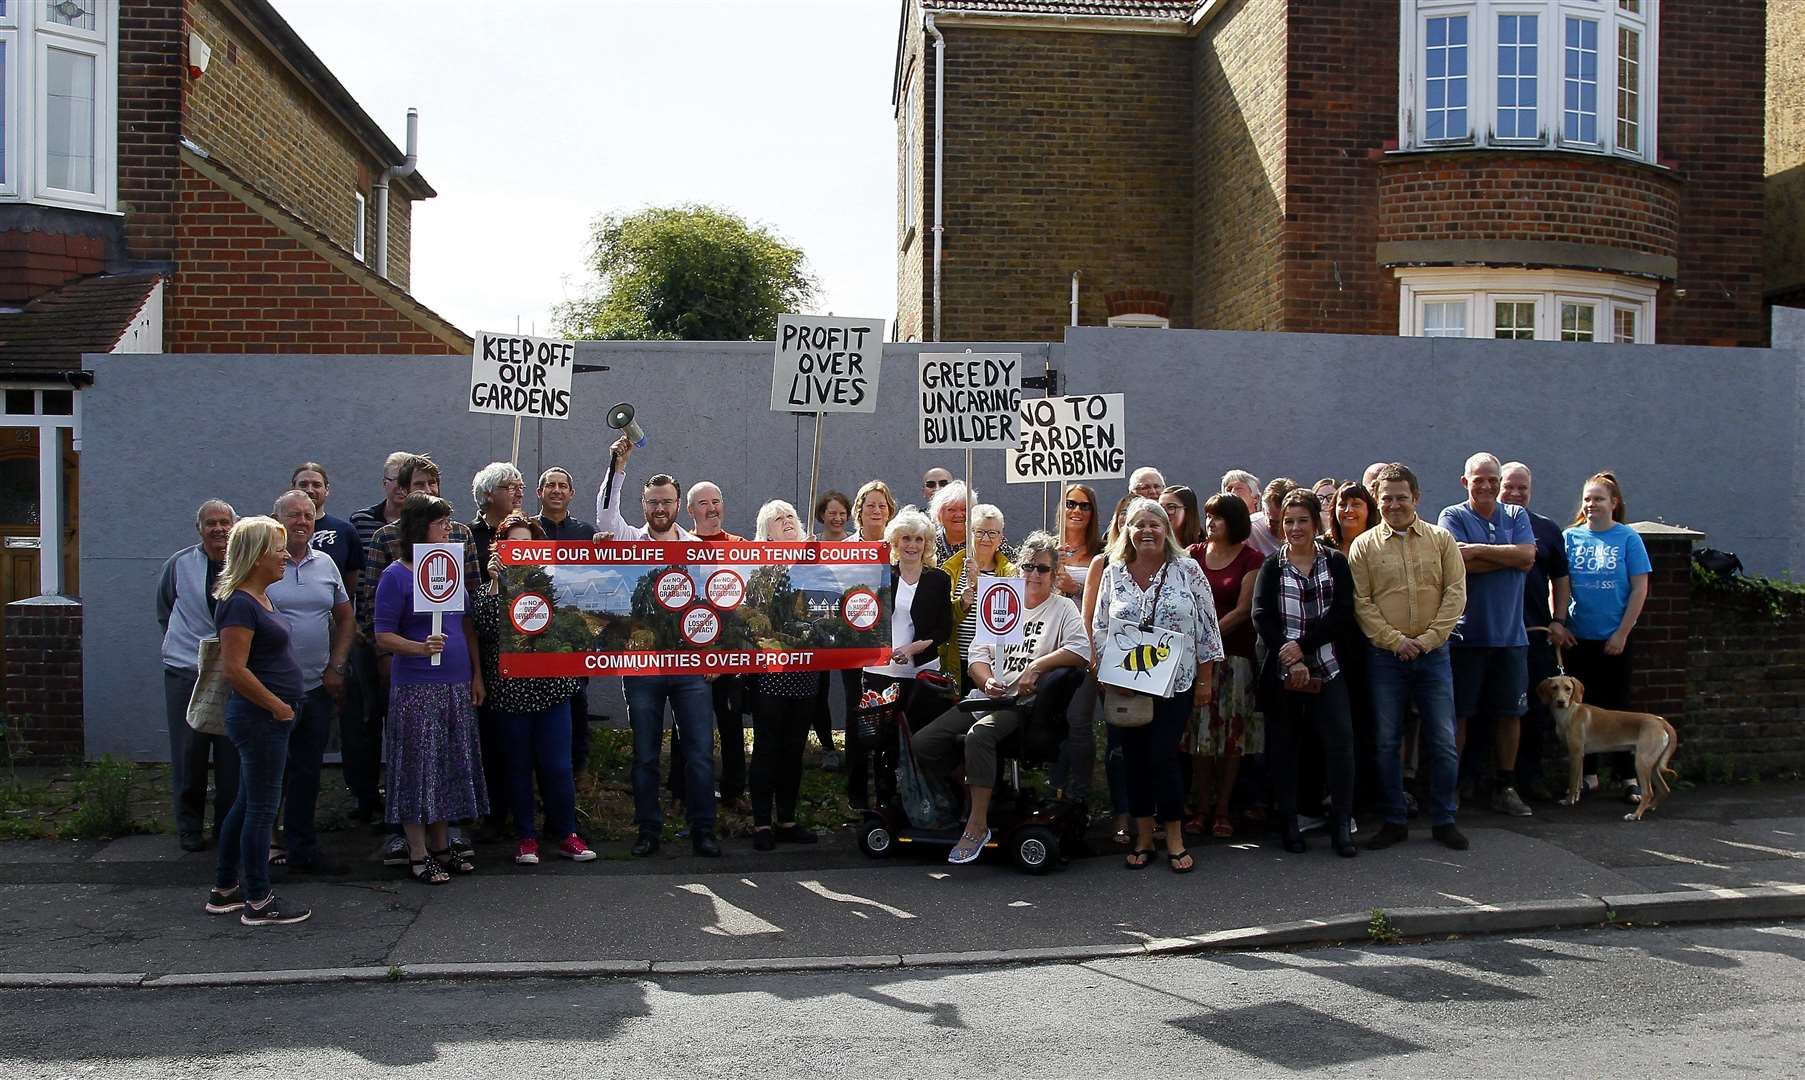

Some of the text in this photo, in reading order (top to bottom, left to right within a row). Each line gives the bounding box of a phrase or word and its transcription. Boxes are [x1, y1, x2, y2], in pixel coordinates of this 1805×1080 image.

[483, 335, 574, 367] KEEP OFF
[782, 324, 871, 352] PROFIT
[499, 363, 546, 387] OUR
[799, 352, 863, 376] OVER
[922, 360, 1016, 389] GREEDY
[472, 383, 570, 417] GARDENS
[788, 373, 868, 406] LIVES
[922, 388, 1021, 414] UNCARING
[1021, 396, 1107, 427] NO TO
[924, 414, 1016, 444] BUILDER
[1015, 448, 1124, 476] GRABBING
[511, 547, 664, 561] SAVE OUR WILDLIFE
[686, 548, 878, 561] SAVE OUR TENNIS COURTS
[584, 652, 813, 669] COMMUNITIES OVER PROFIT
